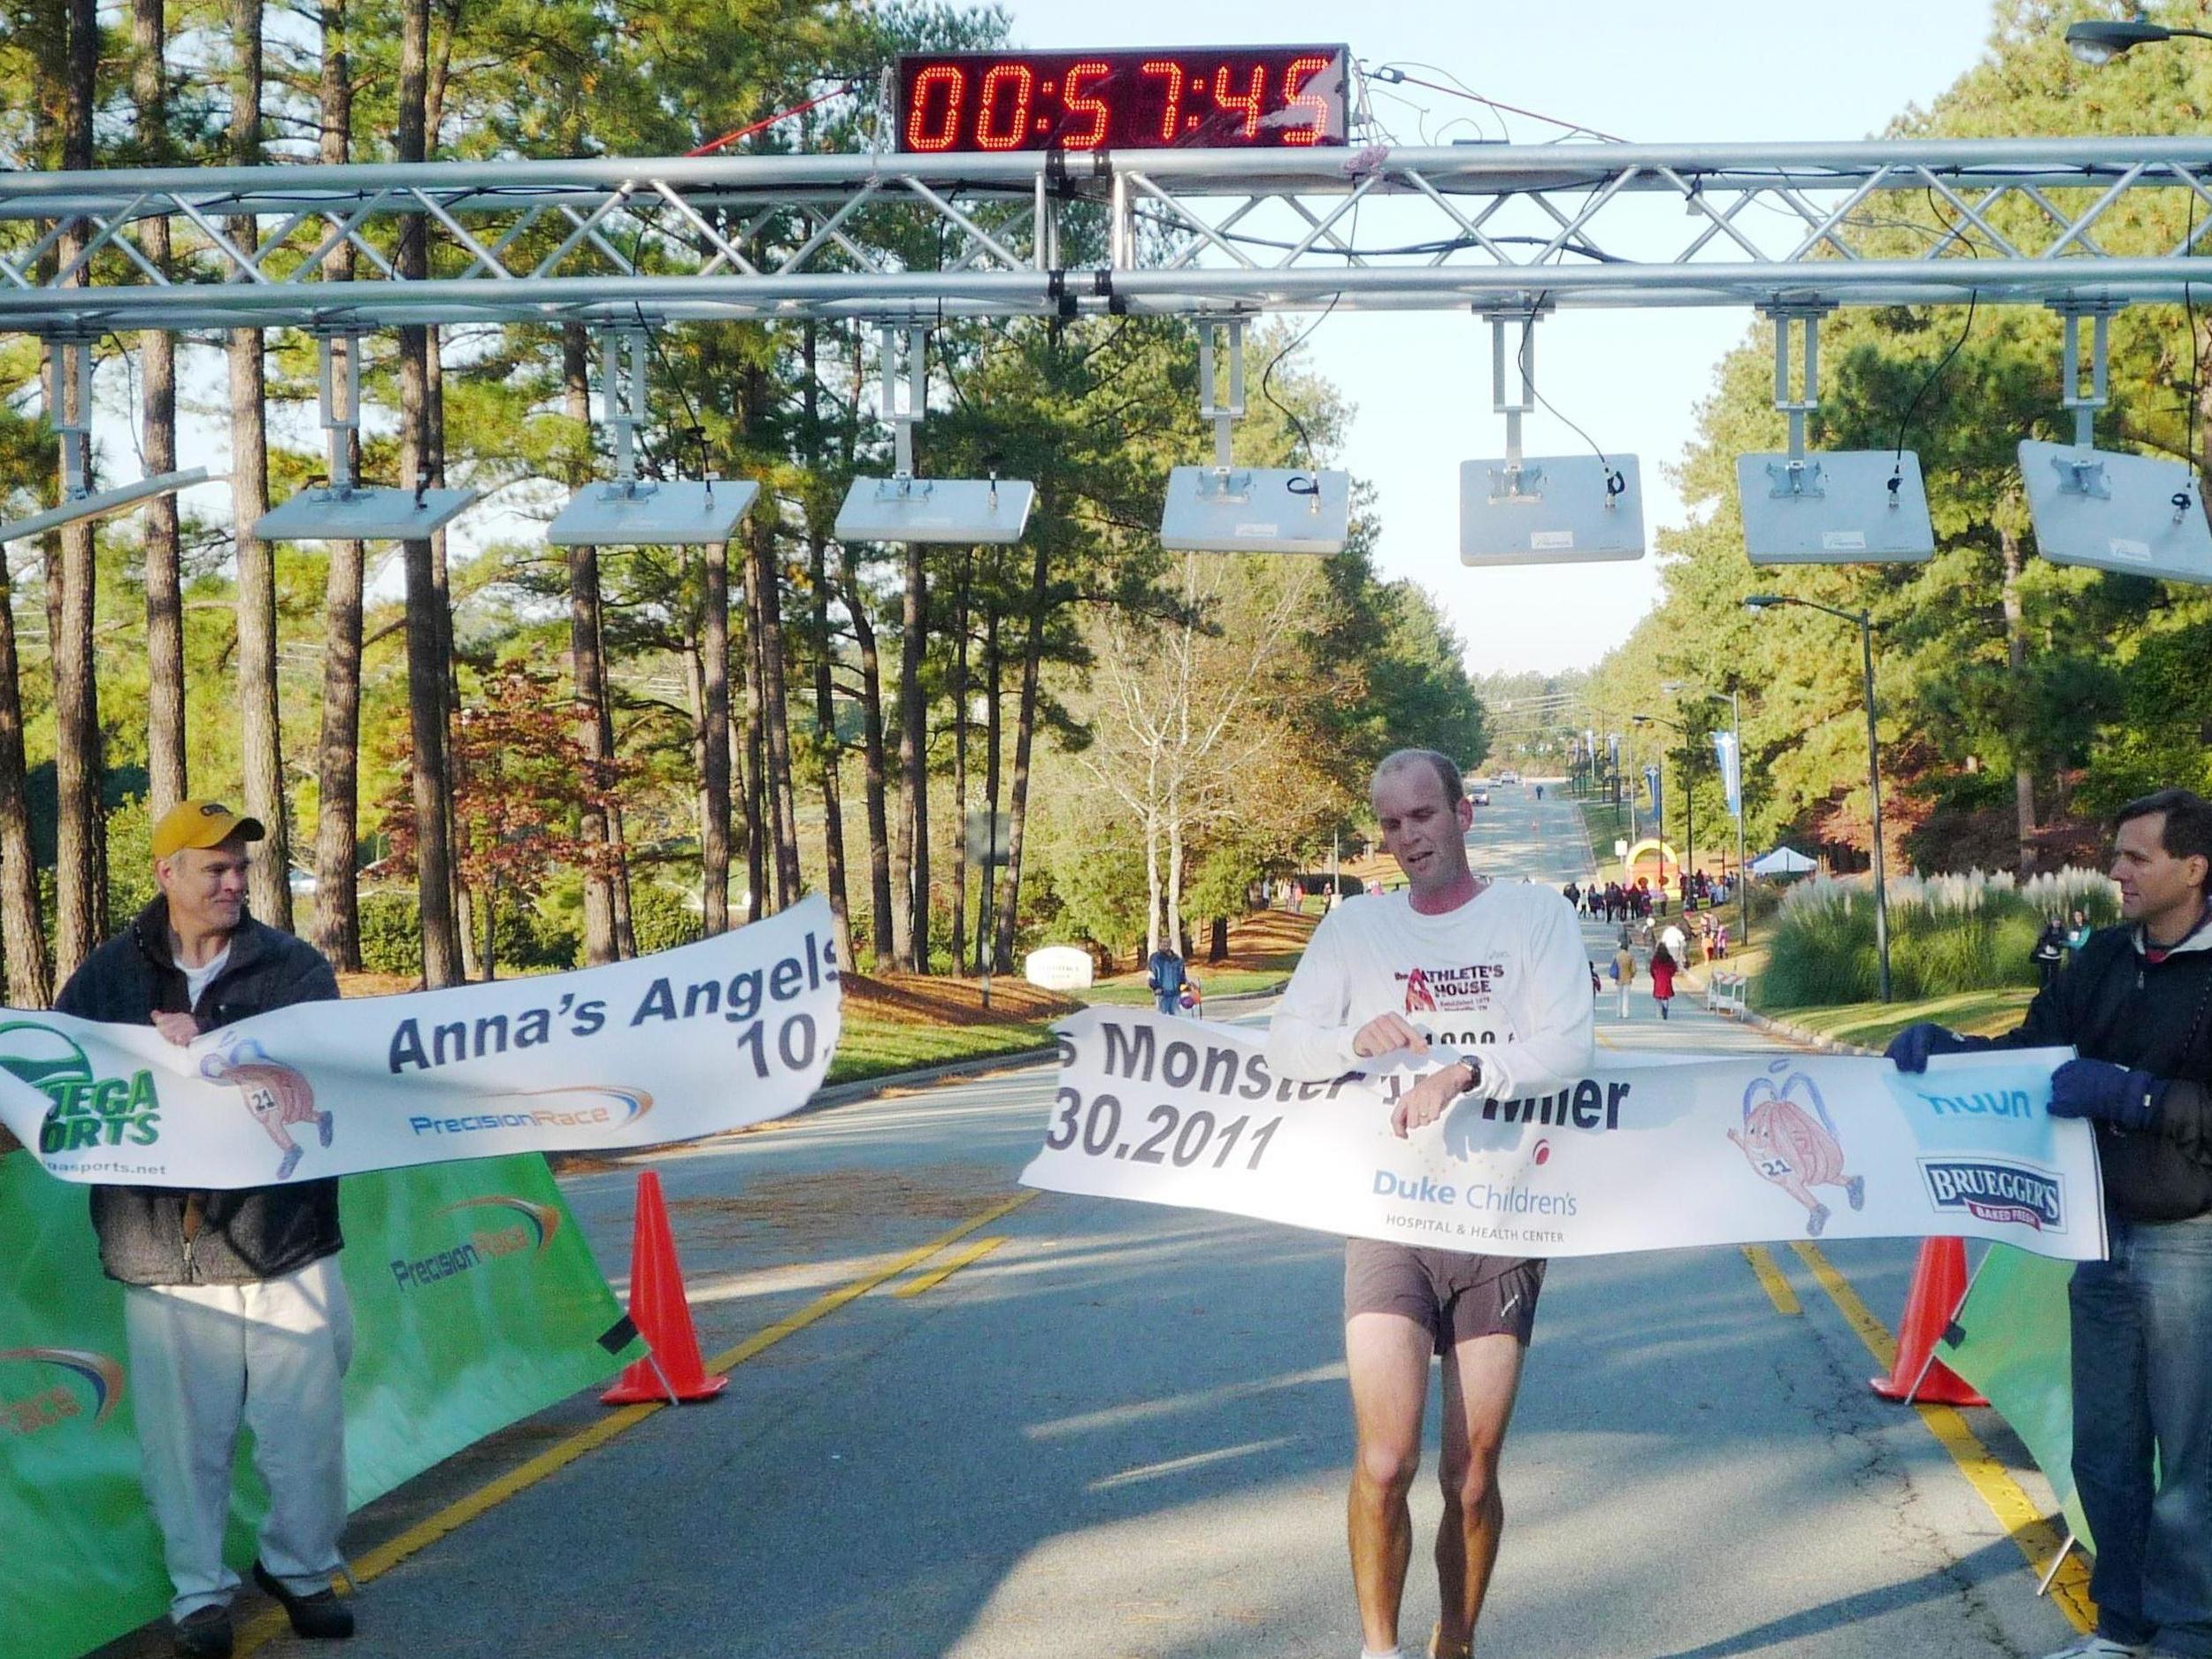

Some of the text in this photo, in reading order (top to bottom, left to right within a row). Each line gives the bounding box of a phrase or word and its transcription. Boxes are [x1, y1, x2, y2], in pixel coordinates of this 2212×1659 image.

[908, 58, 1330, 150] 00:57:45
[1434, 980, 1492, 996] HOUSE
[388, 993, 606, 1074] Anna's
[251, 1089, 275, 1111] 21
[409, 1107, 611, 1136] PrecisionRace
[1047, 1087, 1284, 1170] 30.2011
[1761, 1159, 1792, 1177] 21
[1372, 1170, 1578, 1217] Duke Children's
[1929, 1169, 2059, 1219] BRUEGGER'S
[1386, 1213, 1564, 1243] HOSPITAL & HEALTH CENTER
